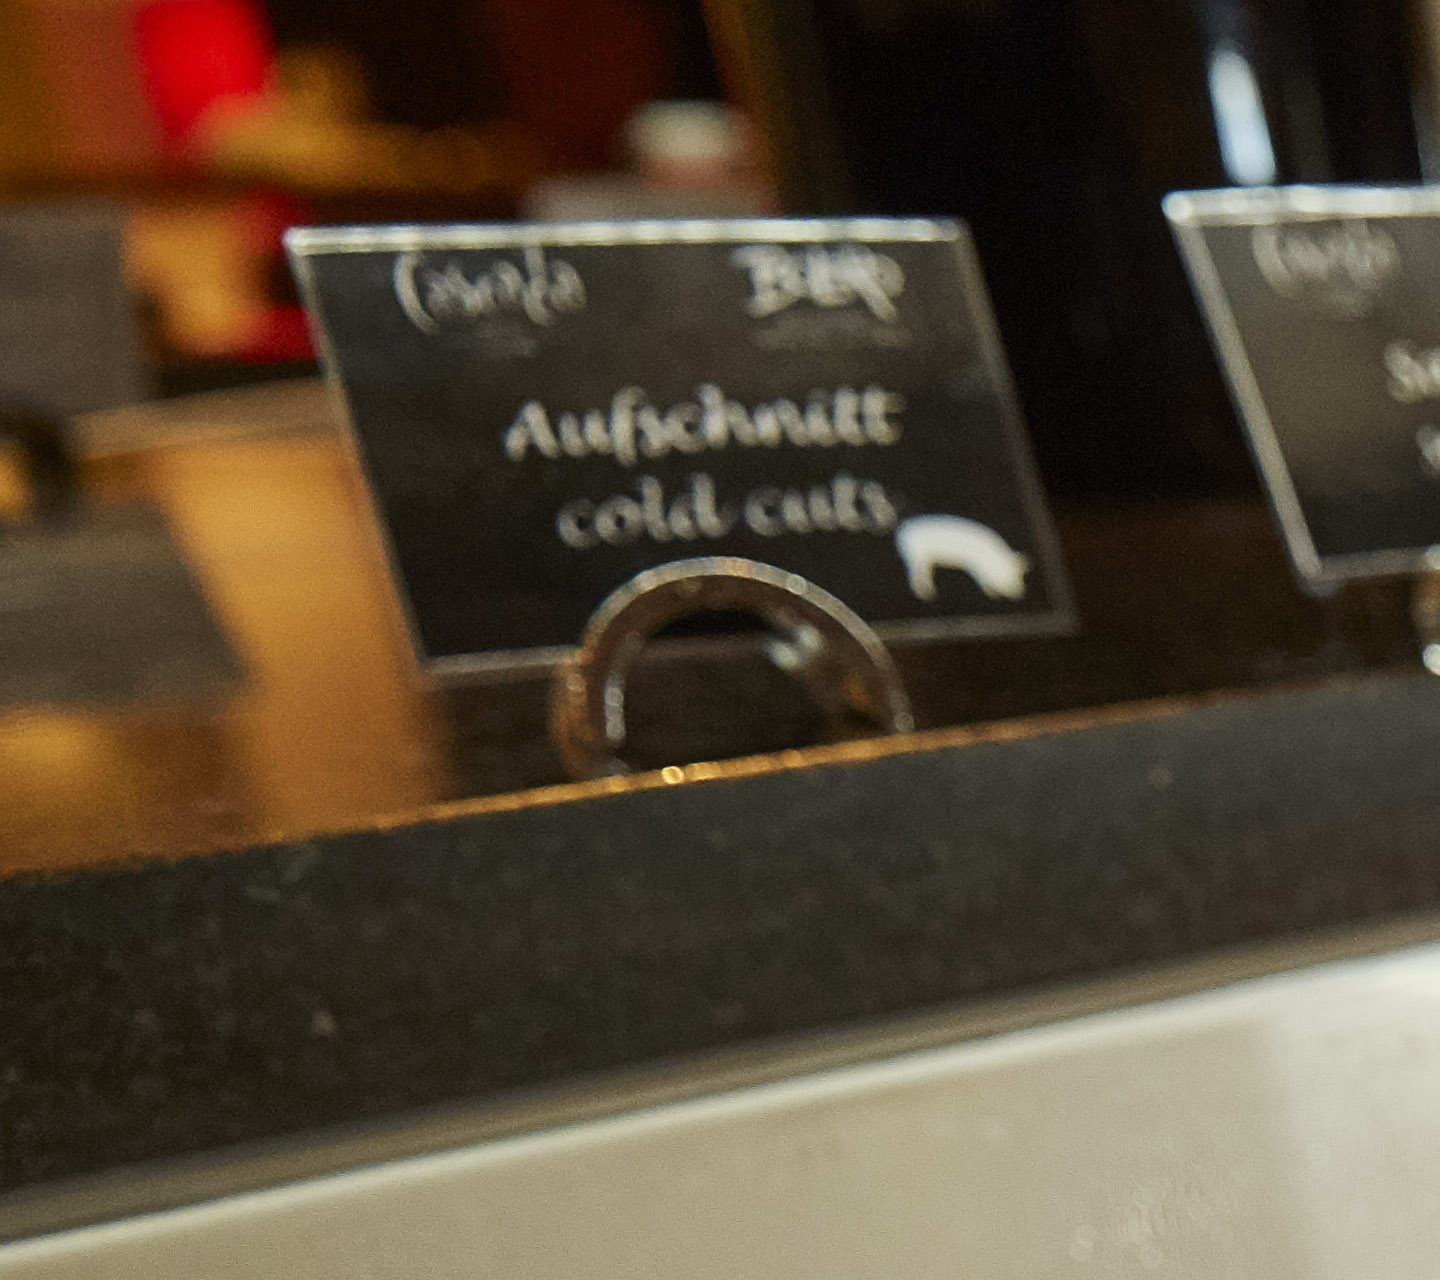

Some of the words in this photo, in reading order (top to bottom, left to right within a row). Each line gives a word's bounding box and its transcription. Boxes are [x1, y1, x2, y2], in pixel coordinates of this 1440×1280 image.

[502, 382, 906, 467] Aufschnitt
[556, 472, 728, 549] cold
[745, 473, 898, 538] cuts
